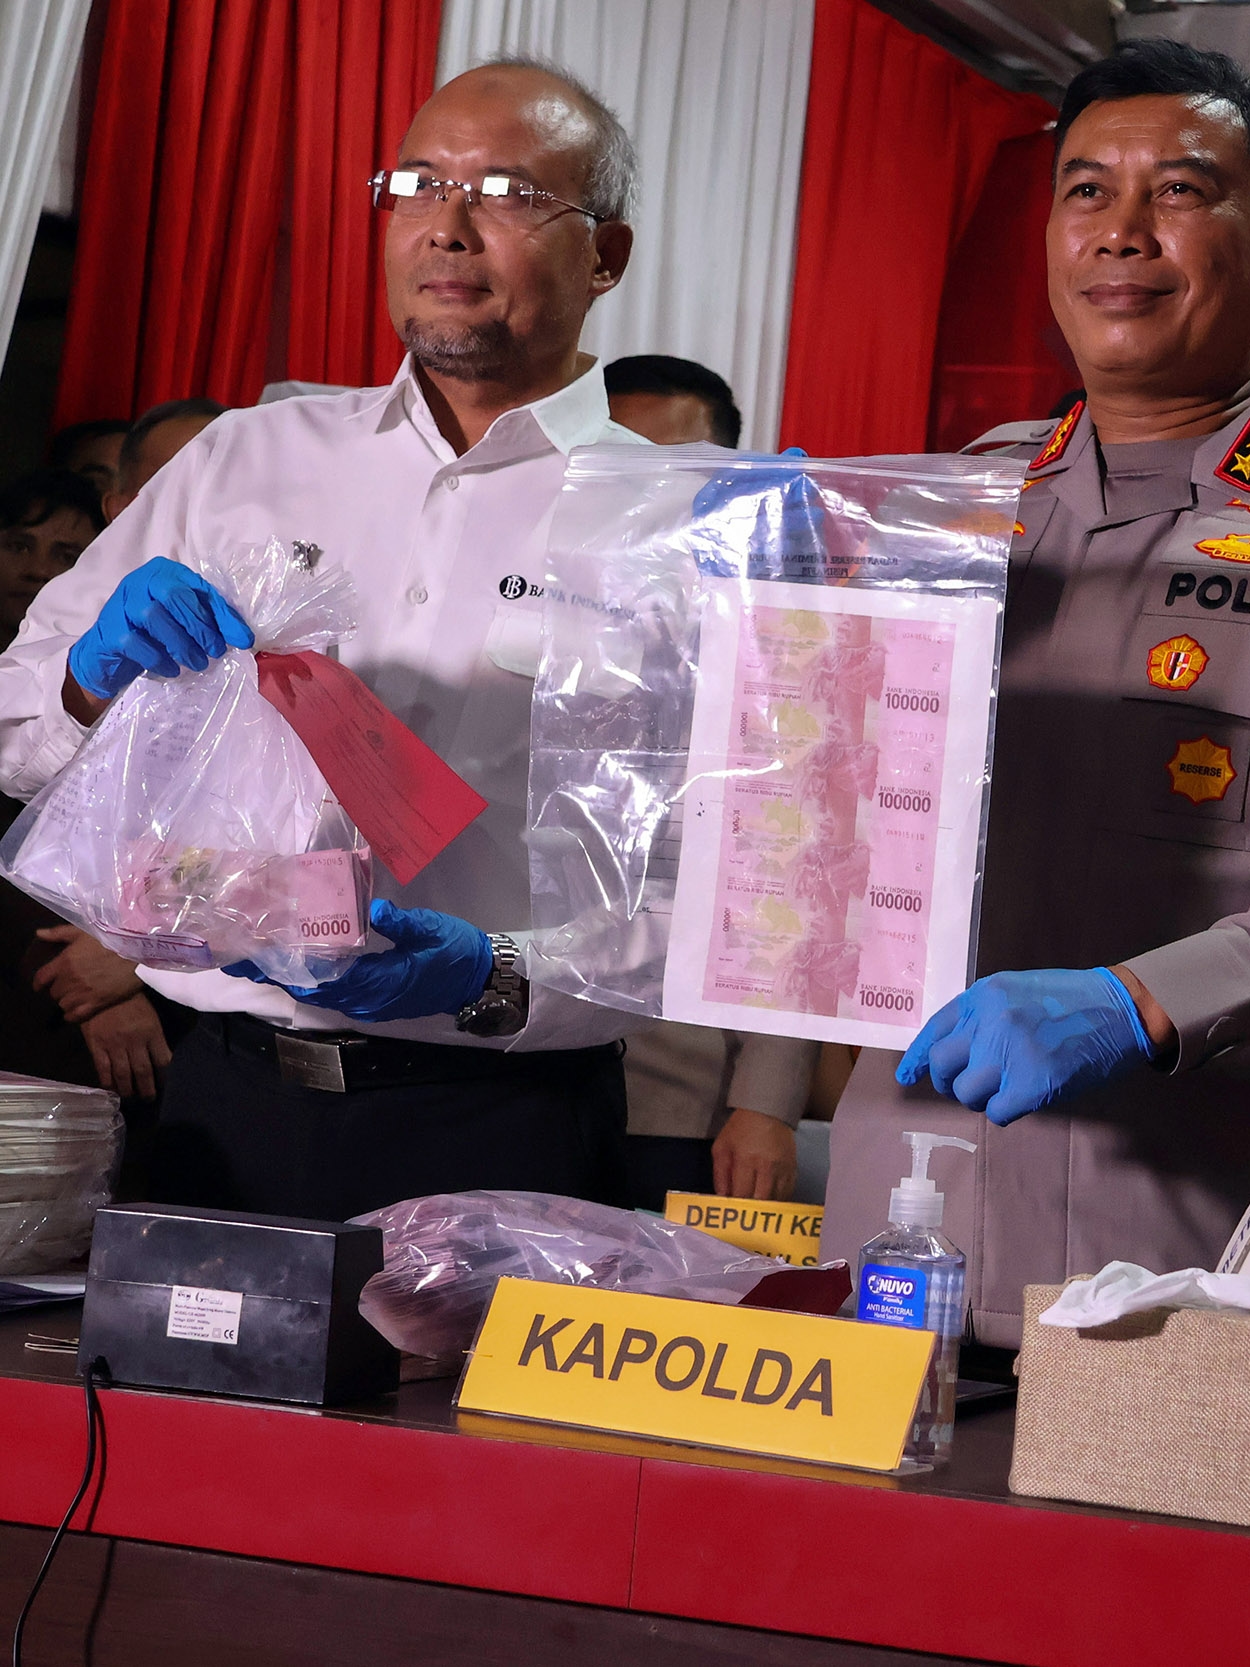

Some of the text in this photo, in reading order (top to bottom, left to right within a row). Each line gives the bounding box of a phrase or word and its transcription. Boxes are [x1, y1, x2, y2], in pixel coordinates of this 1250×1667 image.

[885, 692, 940, 713] 100000
[1179, 763, 1222, 778] RESERSE
[878, 792, 931, 813] 100000
[869, 891, 922, 913] 100000
[859, 990, 914, 1012] 100000
[686, 1204, 783, 1235] DEPUTI
[879, 1278, 914, 1296] NUVO
[866, 1302, 915, 1317] ANTI BACTERIAL
[518, 1313, 834, 1416] KAPOLDA
